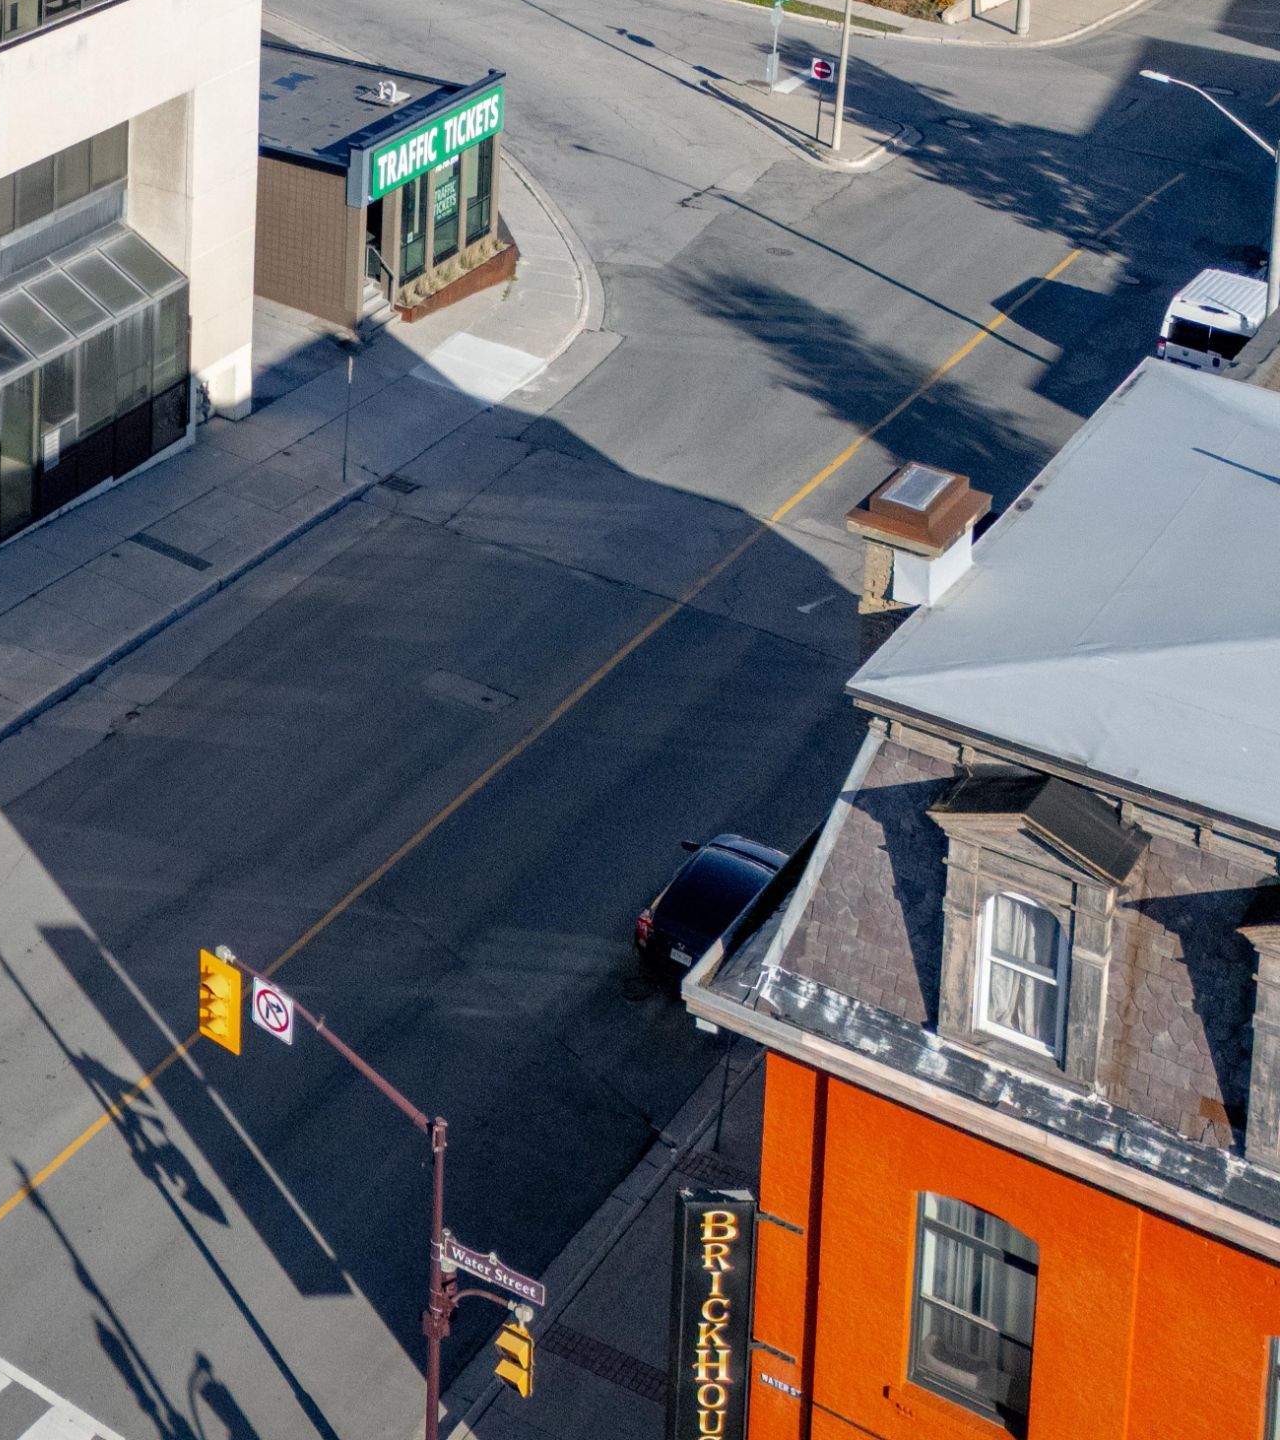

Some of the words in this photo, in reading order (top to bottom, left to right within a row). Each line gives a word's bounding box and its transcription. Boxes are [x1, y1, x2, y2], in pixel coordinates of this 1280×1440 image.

[378, 127, 438, 190] TRAFFIC
[444, 94, 499, 154] TICKETS
[451, 1246, 491, 1276] Water
[494, 1268, 537, 1299] Street
[692, 1209, 738, 1440] BRICKHOU
[761, 1372, 789, 1393] WATER
